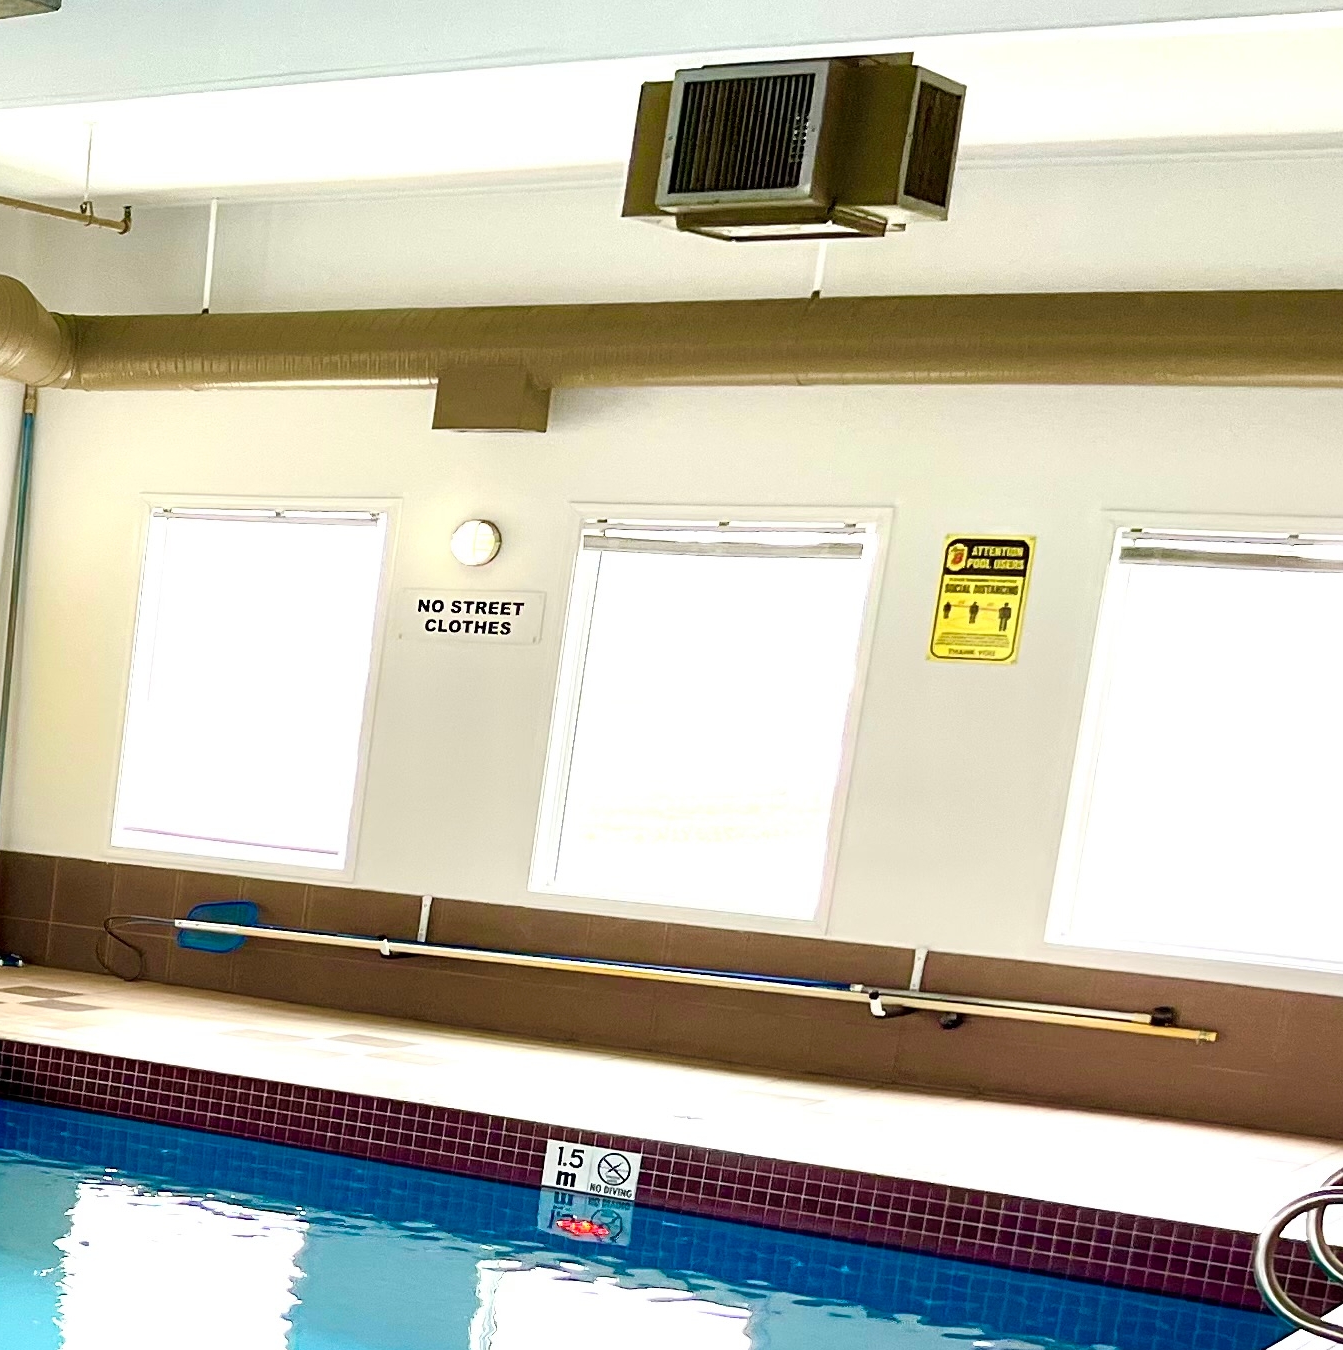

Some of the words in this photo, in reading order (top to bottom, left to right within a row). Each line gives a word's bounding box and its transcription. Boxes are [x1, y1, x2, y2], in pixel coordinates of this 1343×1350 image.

[972, 546, 1023, 556] ATTENTION
[417, 599, 445, 613] NO
[450, 600, 525, 616] STREET
[425, 618, 512, 636] CLOTHES
[557, 1146, 585, 1169] 1.5
[555, 1170, 577, 1188] m
[589, 1182, 602, 1193] NO
[603, 1186, 633, 1199] DIVING
